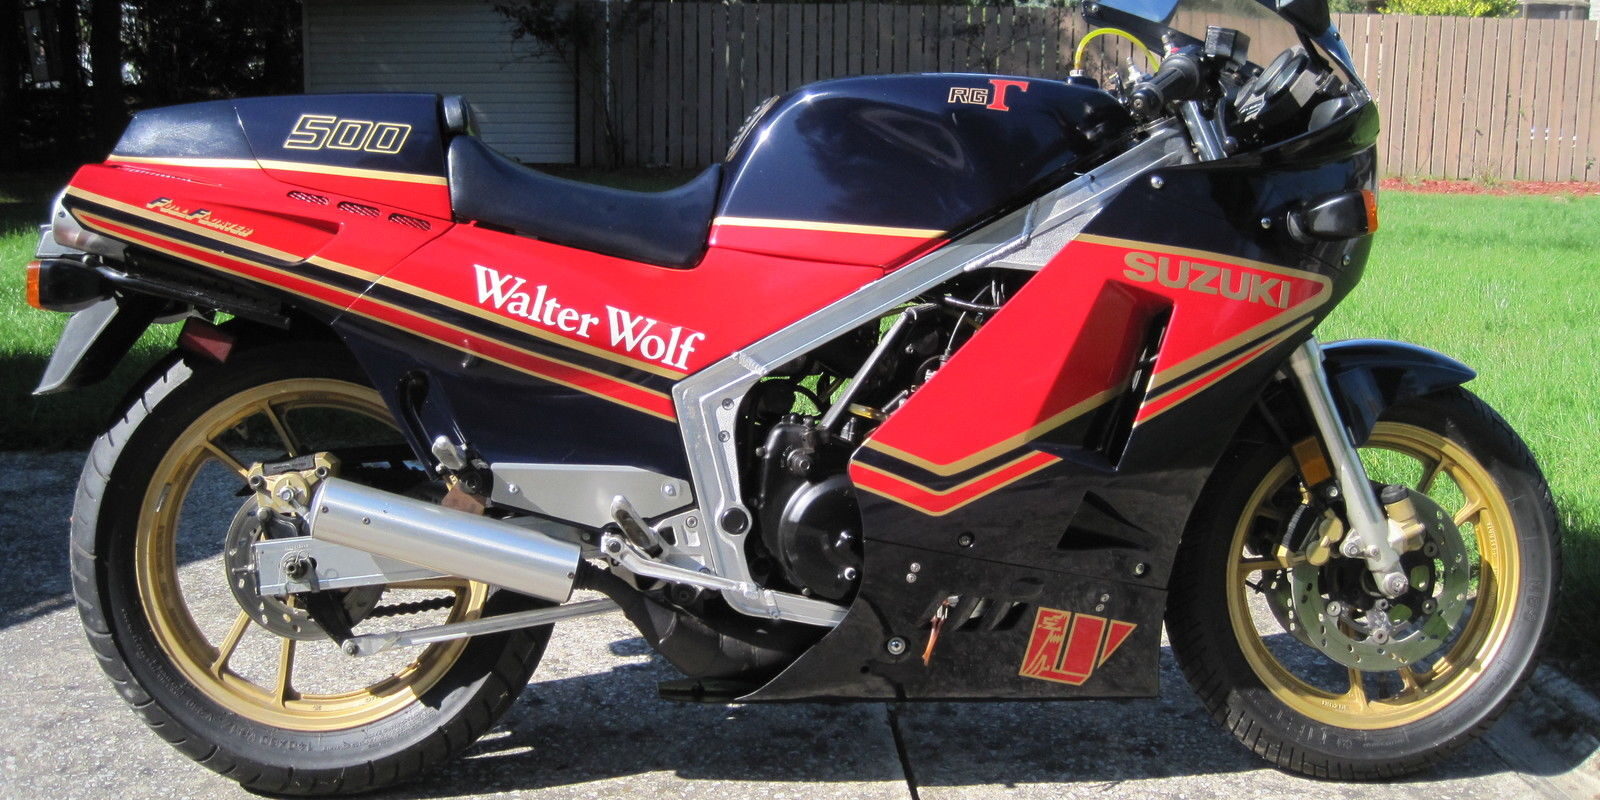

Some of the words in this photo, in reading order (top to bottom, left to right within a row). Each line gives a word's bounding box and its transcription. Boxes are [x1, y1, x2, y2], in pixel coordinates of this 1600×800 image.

[283, 114, 412, 154] 500
[1123, 251, 1292, 309] SUZUKI
[473, 263, 600, 338] Walter
[605, 304, 705, 370] Wolf
